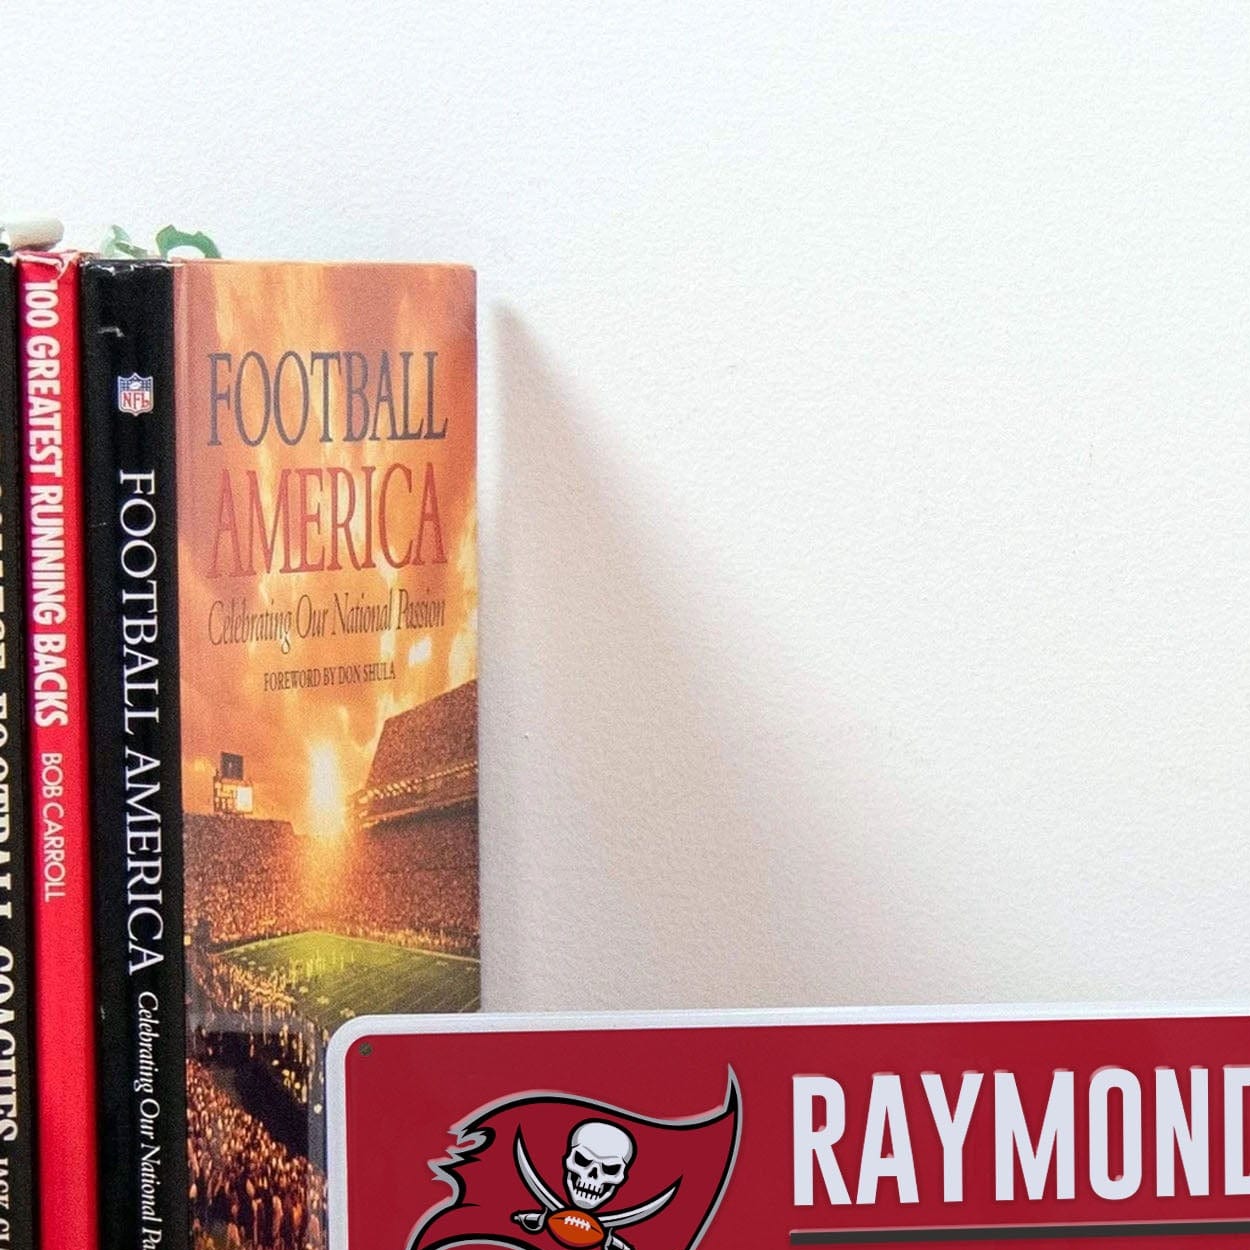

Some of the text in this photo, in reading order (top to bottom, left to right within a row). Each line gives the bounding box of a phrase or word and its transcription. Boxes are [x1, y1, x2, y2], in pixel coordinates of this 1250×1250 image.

[122, 391, 152, 410] NFL
[207, 350, 448, 447] FOOTBALL
[24, 282, 69, 728] 100 GREATEST RUNNING BACKS
[207, 461, 448, 579] AMERICA
[208, 587, 446, 655] Celebrating Our National Passion
[119, 469, 165, 976] FOOTBALL AMERICA
[263, 662, 397, 692] FOREWORD BY DON SHULA
[41, 753, 66, 903] BOB CARROLL
[134, 992, 159, 1093] Celebrating
[139, 1098, 160, 1139] Our
[141, 1142, 162, 1223] National
